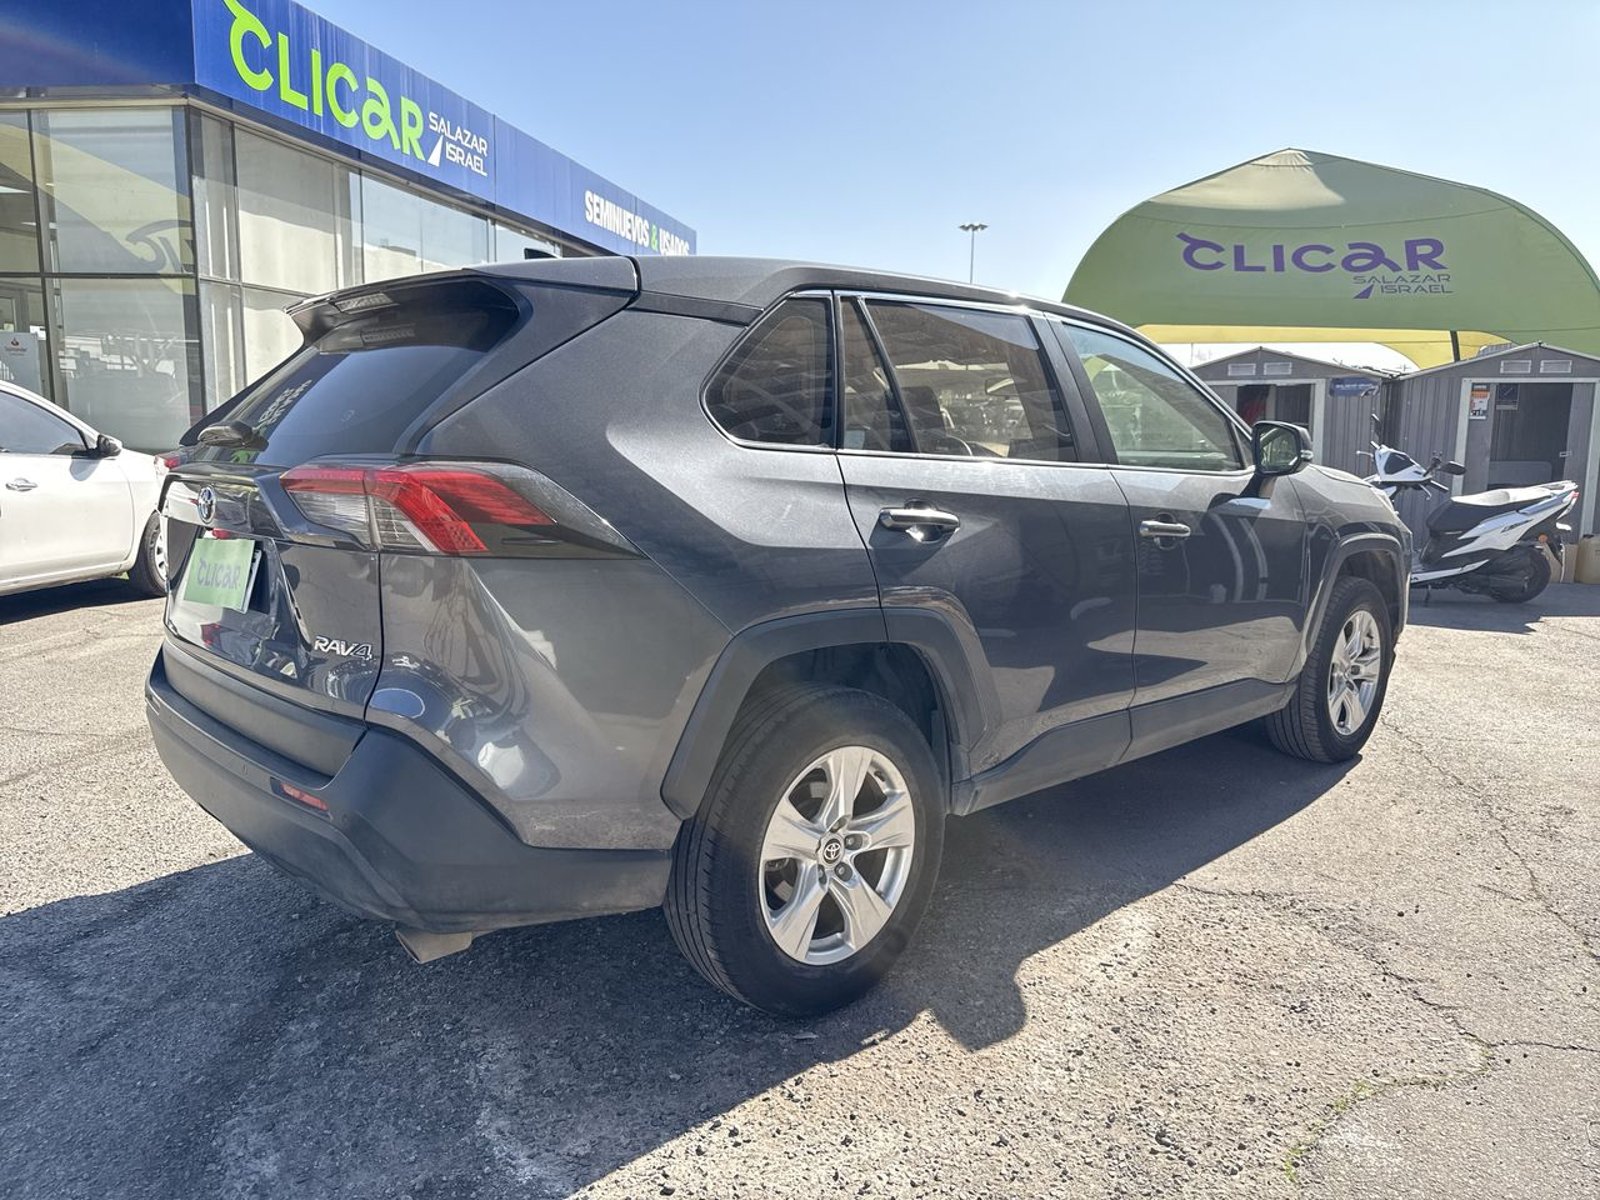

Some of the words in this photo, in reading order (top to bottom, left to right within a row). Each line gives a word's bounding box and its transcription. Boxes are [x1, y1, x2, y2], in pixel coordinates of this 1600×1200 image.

[428, 111, 488, 157] SALAZAR
[445, 141, 488, 177] ISRAEL
[584, 190, 650, 248] SEMINUEVOS
[651, 224, 658, 252] &
[1352, 274, 1451, 285] SALAZAR
[1380, 283, 1453, 295] ISRAEL
[314, 635, 373, 661] RAV4
